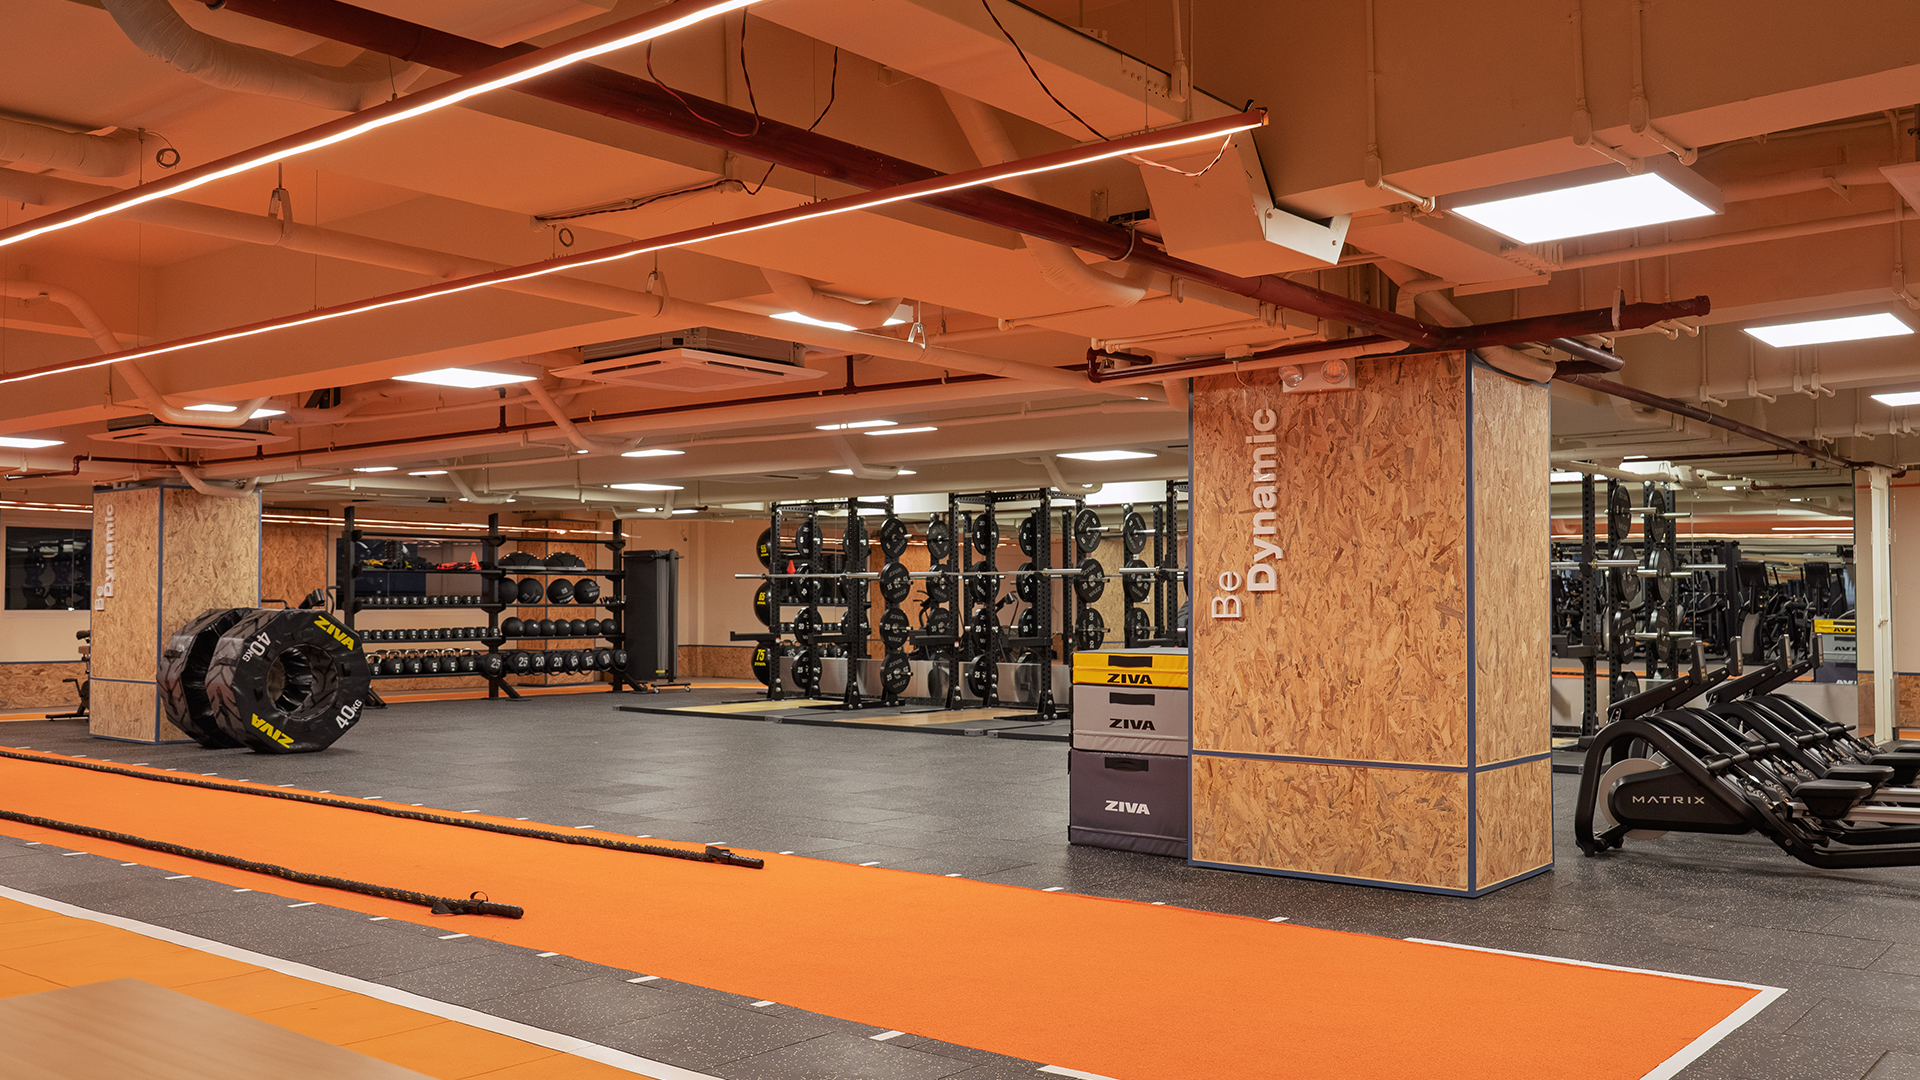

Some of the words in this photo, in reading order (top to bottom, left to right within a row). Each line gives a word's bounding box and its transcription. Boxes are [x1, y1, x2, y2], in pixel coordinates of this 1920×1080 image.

[1246, 408, 1284, 592] Dynamic
[104, 504, 114, 597] Dynamic
[760, 544, 767, 553] 55
[94, 586, 105, 610] Be
[1211, 571, 1242, 618] Be
[314, 615, 355, 650] ZIVA
[602, 654, 610, 664] 10
[756, 649, 765, 661] 75
[491, 658, 501, 669] 25
[519, 656, 528, 667] 25
[536, 656, 545, 666] 20
[554, 657, 563, 667] 20
[586, 656, 593, 666] 15
[1107, 674, 1153, 684] ZIVA
[1109, 718, 1156, 731] ZIVA
[251, 713, 294, 748] ZIVA
[1632, 796, 1705, 804] MATRIX
[1104, 800, 1150, 815] ZIVA
